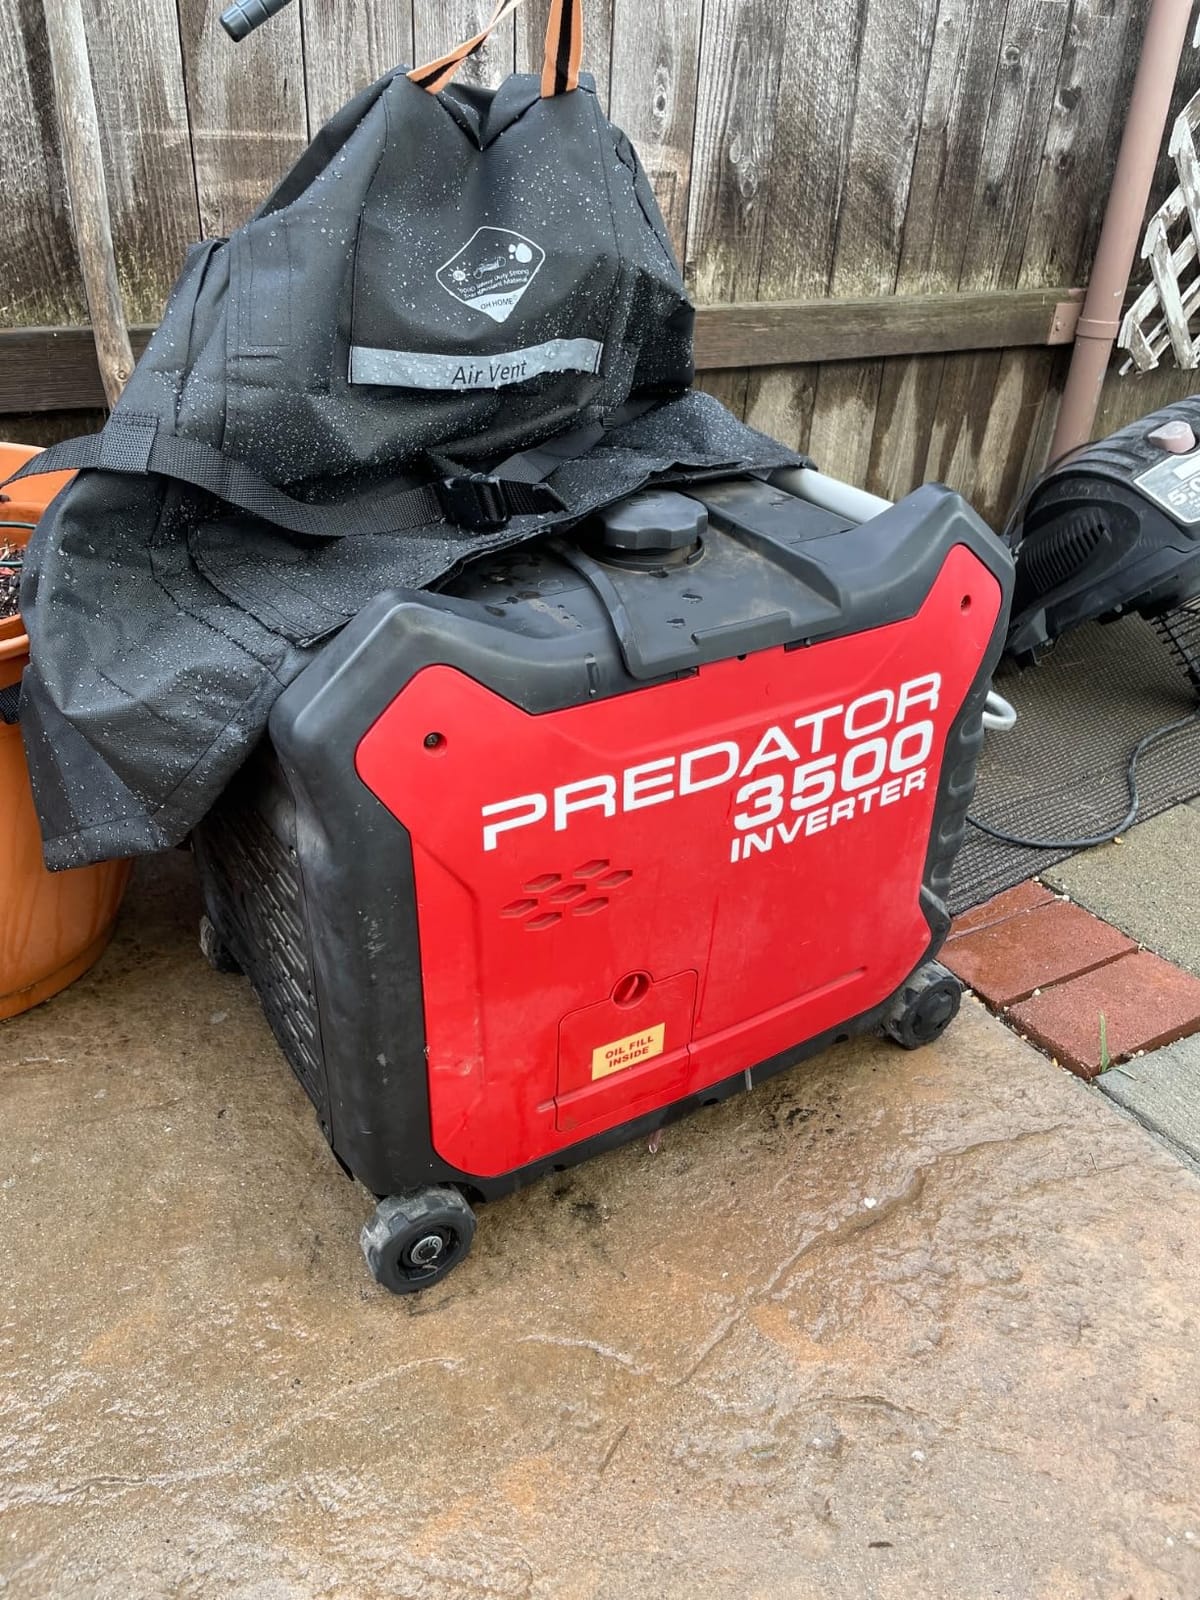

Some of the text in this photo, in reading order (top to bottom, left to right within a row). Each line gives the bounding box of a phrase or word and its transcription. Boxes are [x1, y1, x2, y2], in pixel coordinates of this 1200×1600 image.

[492, 298, 513, 307] HOME
[451, 360, 527, 384] Air Vent
[481, 672, 941, 851] PREDATOR
[733, 719, 934, 831] 3500
[730, 769, 927, 863] INVERTER
[605, 1036, 654, 1059] OIL FILL
[609, 1046, 649, 1067] INSIDE
